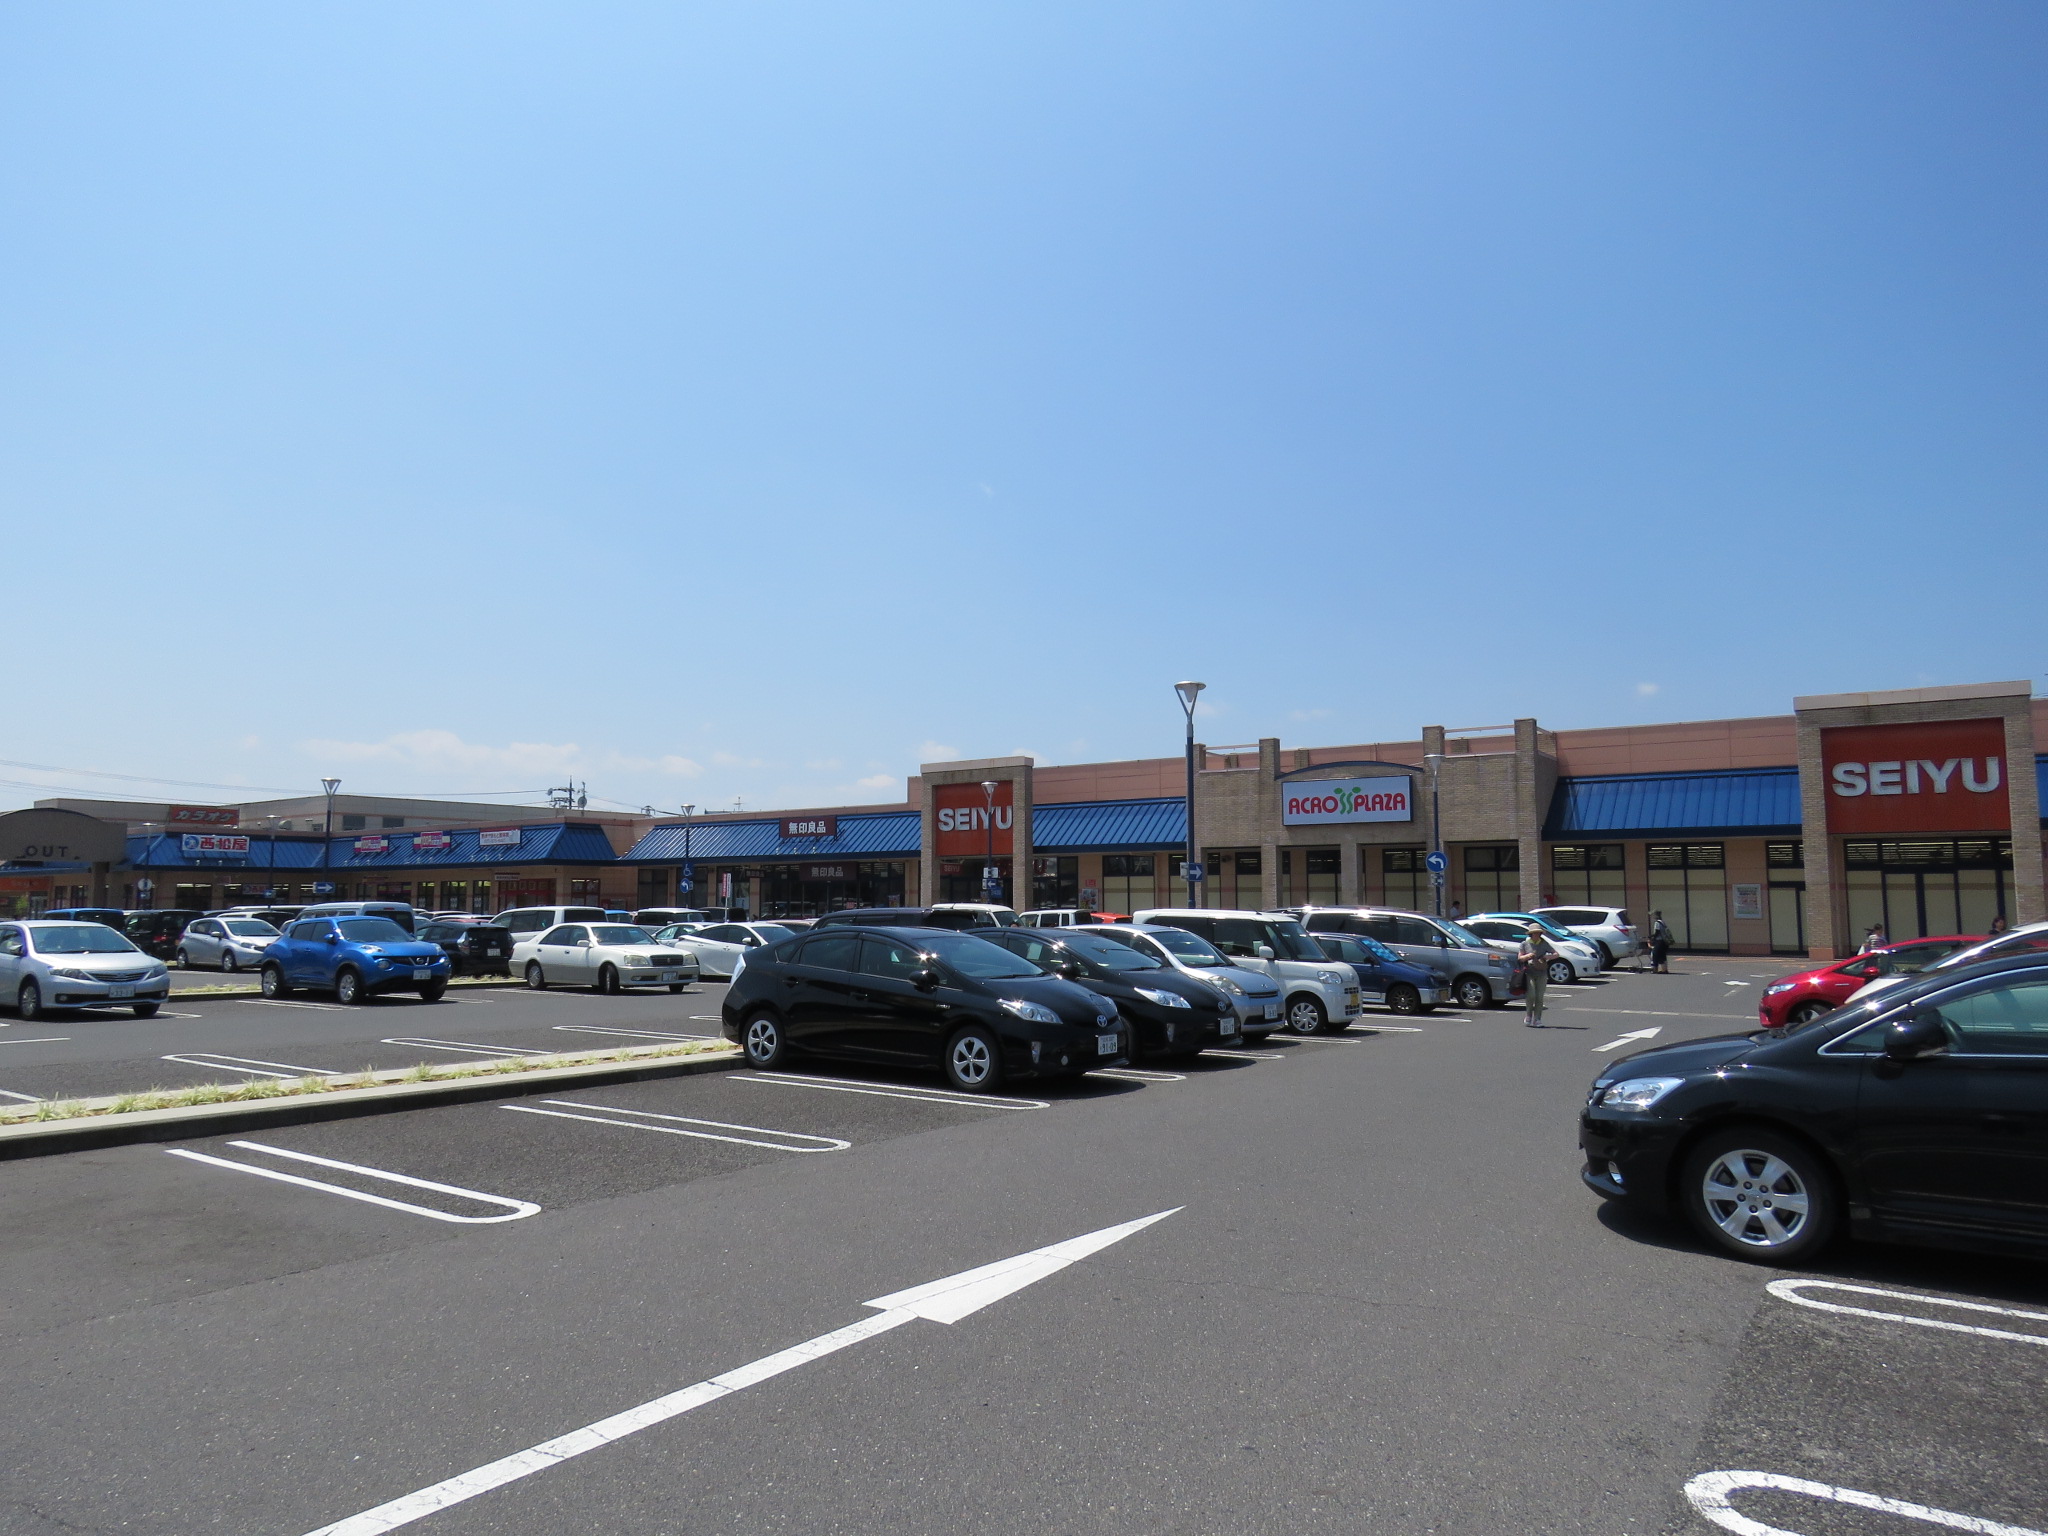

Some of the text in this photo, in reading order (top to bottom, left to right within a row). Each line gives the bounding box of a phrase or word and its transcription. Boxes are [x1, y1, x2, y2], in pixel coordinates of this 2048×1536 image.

[1832, 756, 2000, 797] SEIYU
[1354, 792, 1406, 812] PLAZA
[176, 809, 234, 822] カラオケ
[938, 805, 1013, 831] SEIYU
[788, 821, 826, 834] 無印良品
[200, 837, 248, 851] 西松屋
[25, 845, 68, 857] OUT
[811, 866, 844, 877] 無印良品
